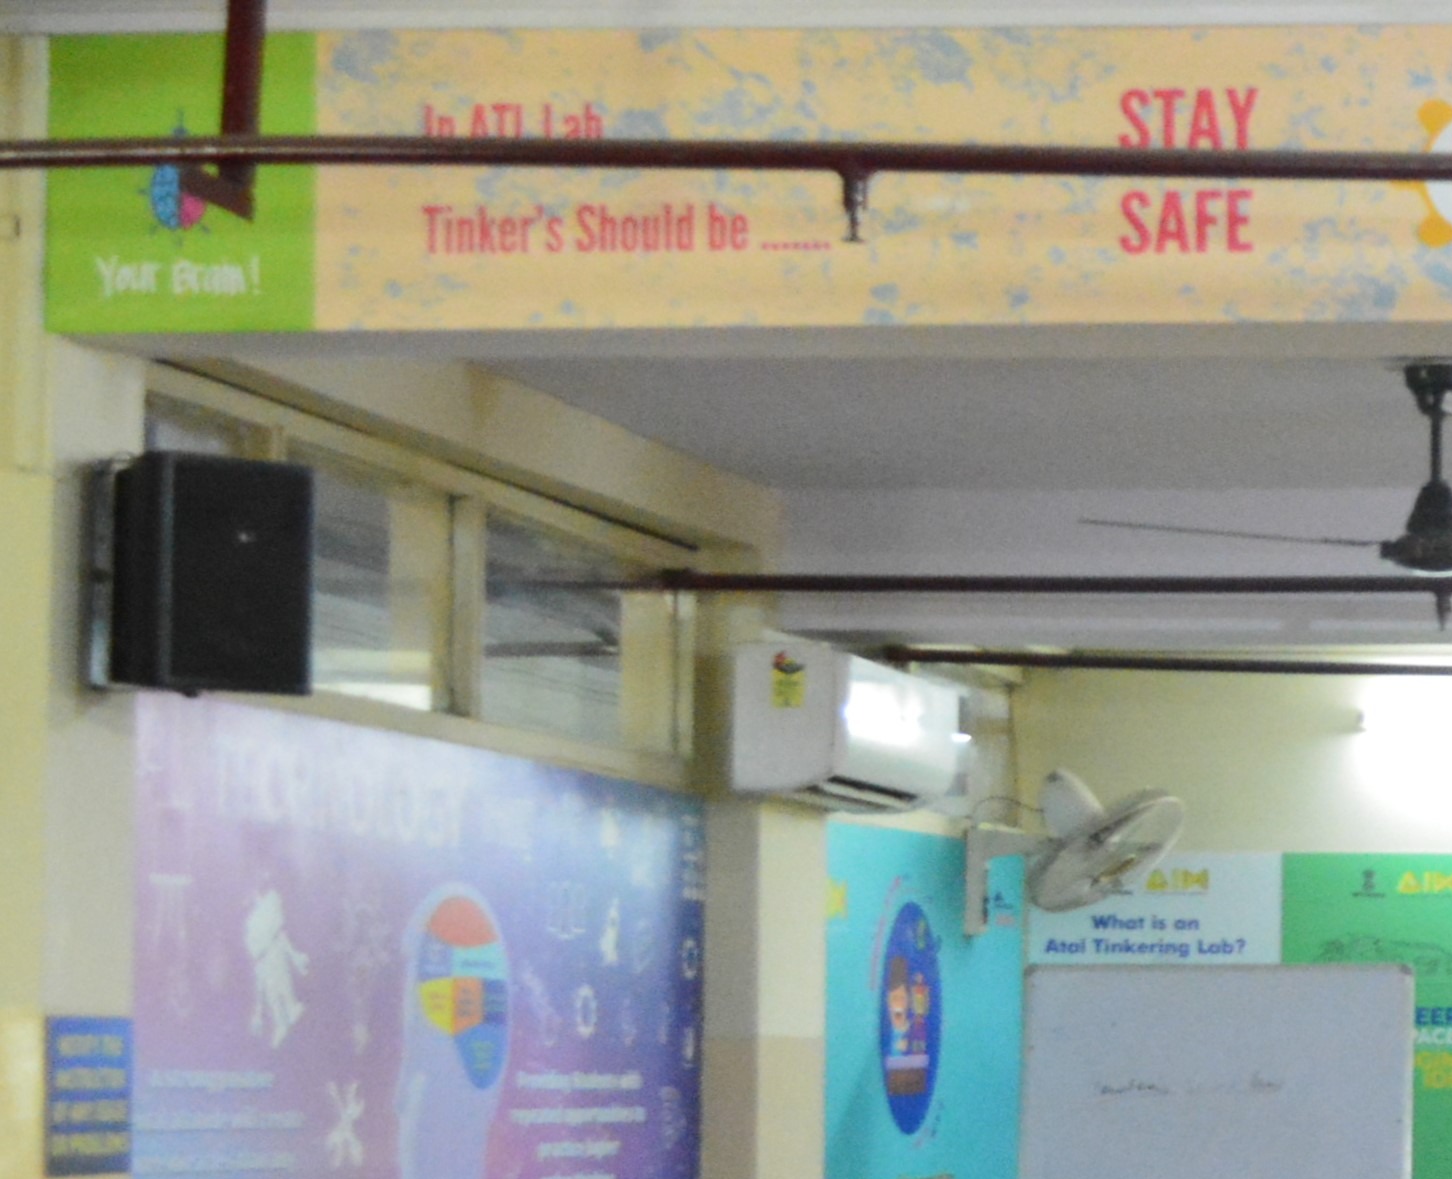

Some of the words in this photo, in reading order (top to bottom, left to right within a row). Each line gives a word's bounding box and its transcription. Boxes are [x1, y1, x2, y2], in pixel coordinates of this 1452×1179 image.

[1118, 87, 1258, 150] STAY
[422, 204, 565, 254] Tinker's
[575, 203, 695, 253] Should
[708, 203, 748, 251] be
[1118, 189, 1254, 254] SAFE
[95, 255, 164, 298] Your
[1091, 914, 1145, 930] What
[1152, 914, 1167, 930] is
[1174, 917, 1200, 930] an
[1093, 938, 1191, 958] Tinkering
[1197, 938, 1247, 955] Lab?
